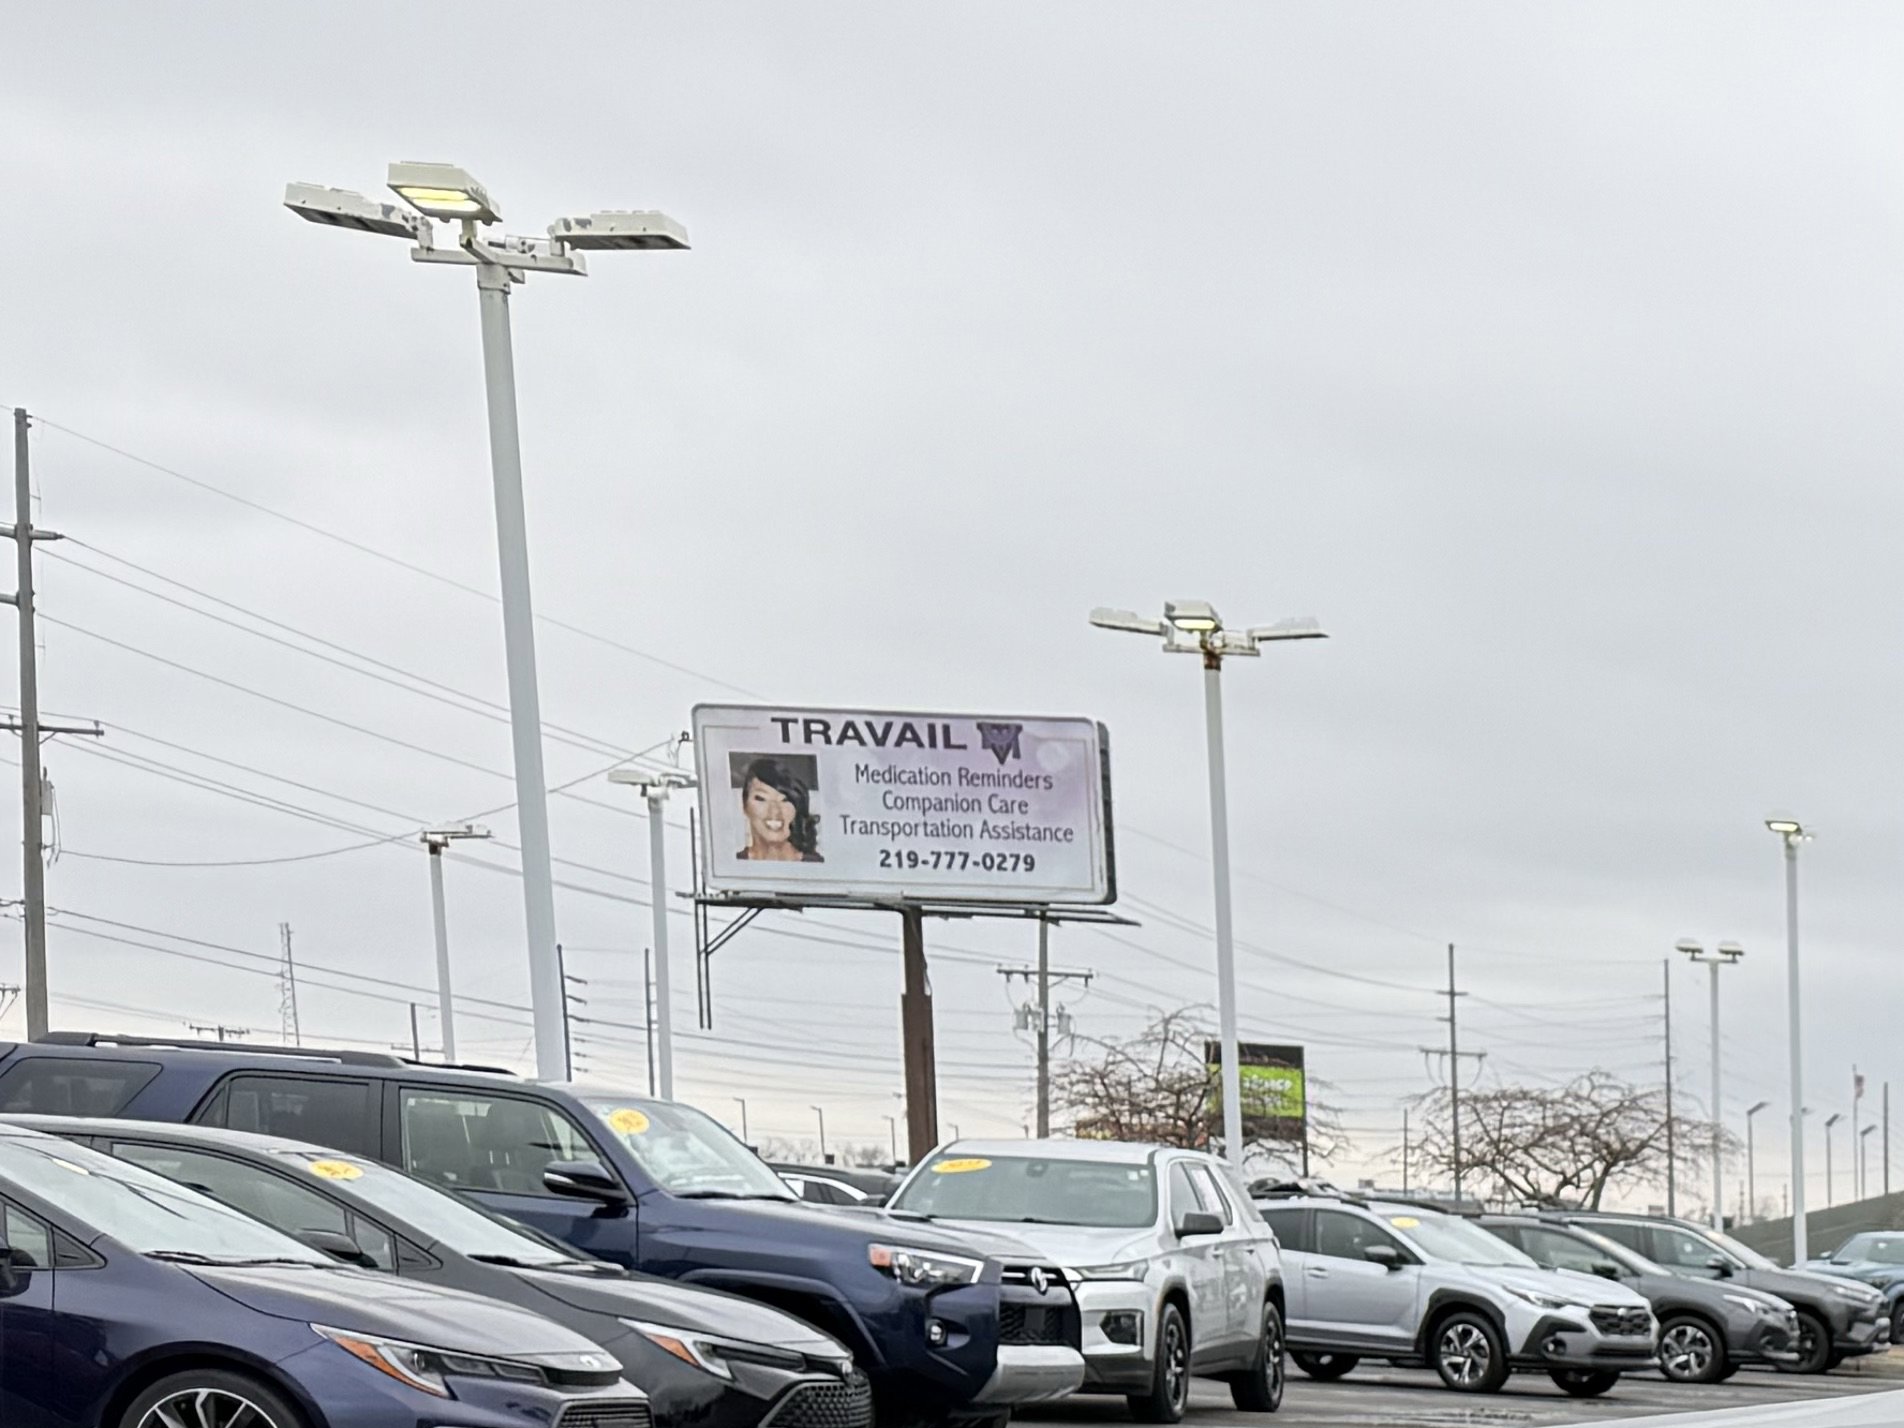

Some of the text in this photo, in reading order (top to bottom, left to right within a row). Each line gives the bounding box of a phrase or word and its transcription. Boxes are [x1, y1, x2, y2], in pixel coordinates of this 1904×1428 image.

[770, 717, 968, 750] TRAVAIL
[855, 763, 1053, 790] Medication Reminders
[882, 790, 1029, 817] Companion Care
[840, 815, 1074, 843] Transportation Assistance
[879, 849, 1036, 872] 219-777-0279
